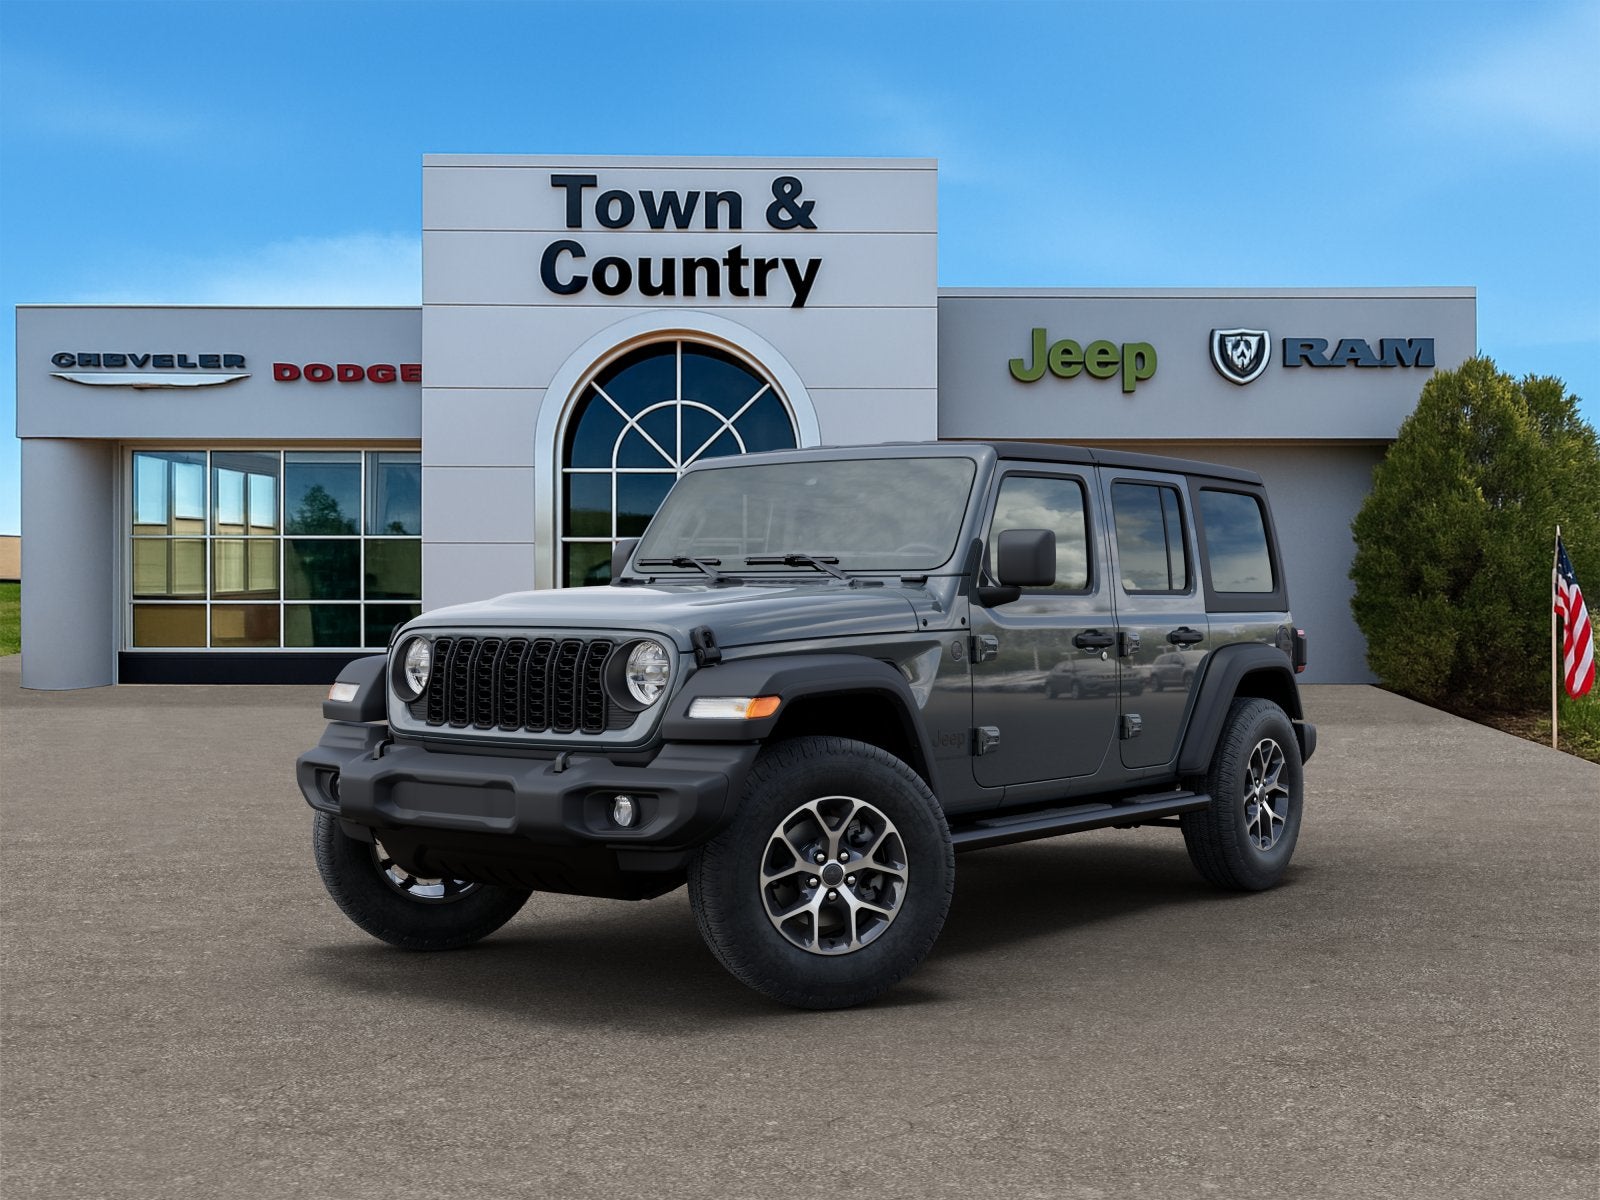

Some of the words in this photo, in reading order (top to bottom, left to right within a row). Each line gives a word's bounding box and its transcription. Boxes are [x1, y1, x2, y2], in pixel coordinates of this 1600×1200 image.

[550, 174, 743, 230] Town
[765, 175, 818, 230] &
[539, 239, 823, 308] Country
[272, 362, 422, 383] DODGE
[1008, 327, 1158, 393] Jeep
[1282, 337, 1436, 367] RAM
[932, 727, 966, 749] Jeep
